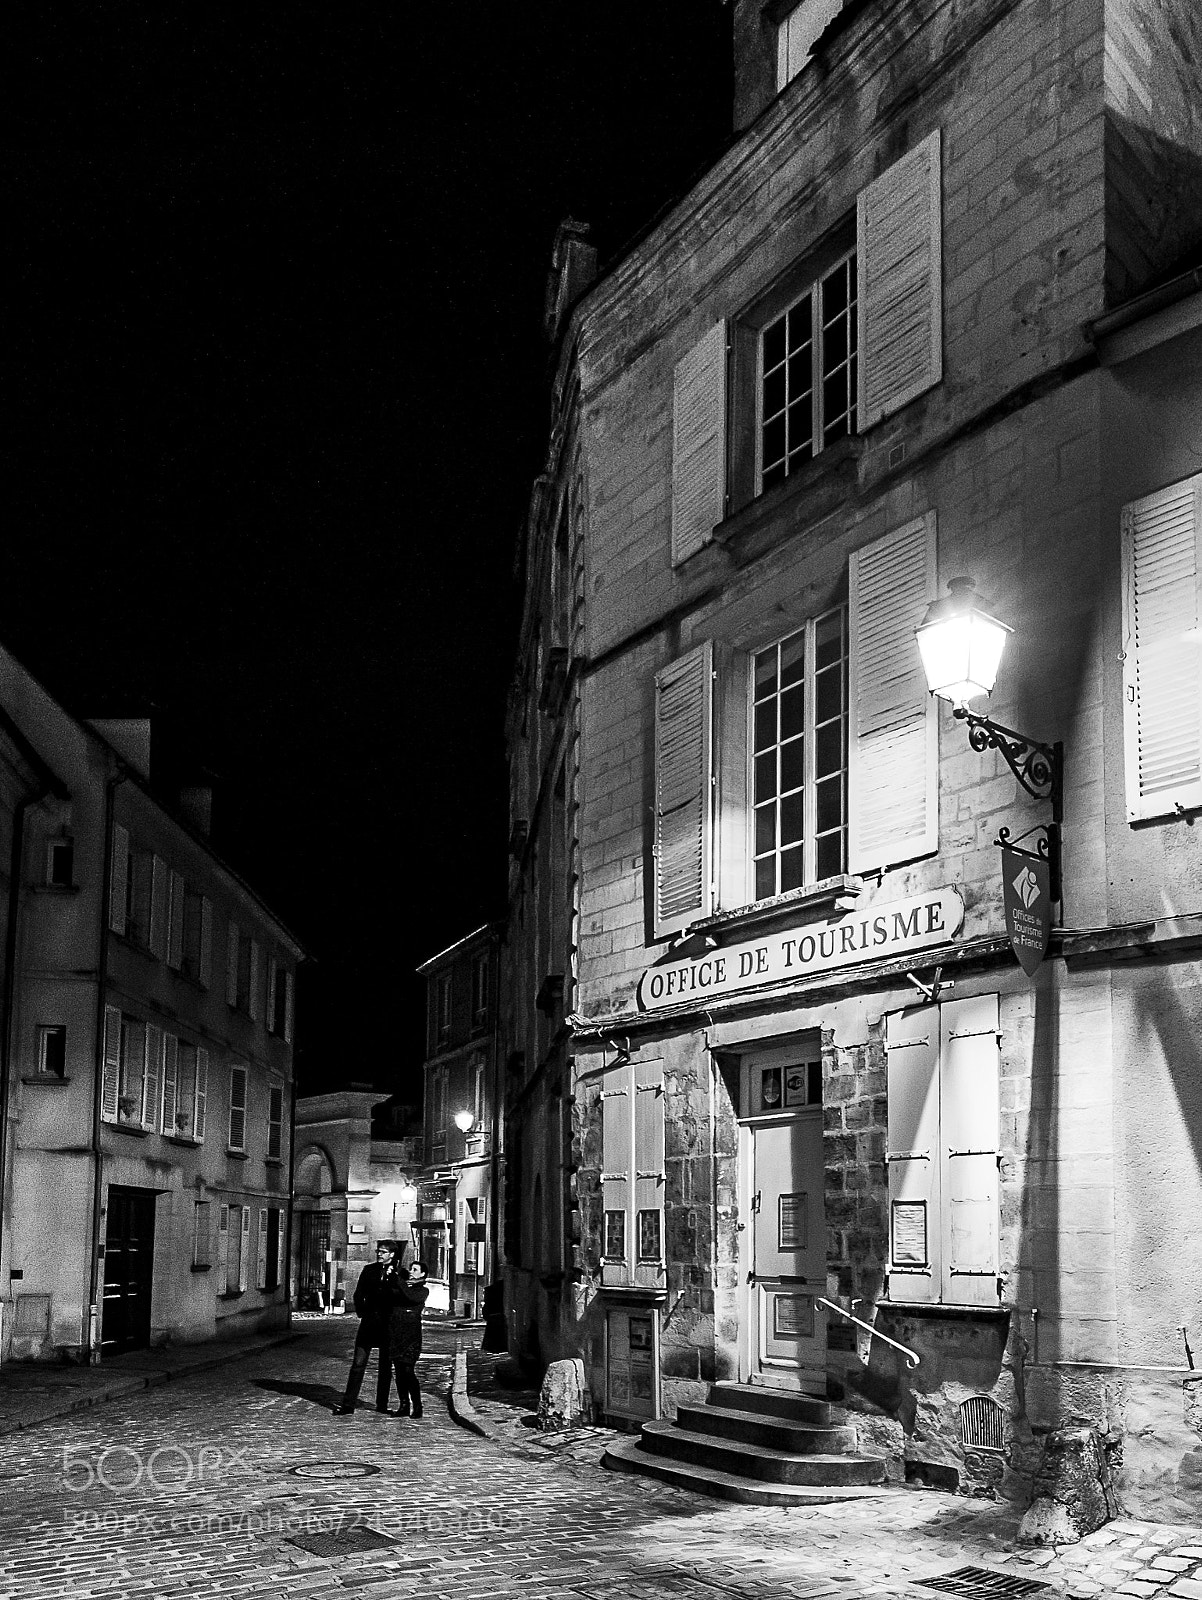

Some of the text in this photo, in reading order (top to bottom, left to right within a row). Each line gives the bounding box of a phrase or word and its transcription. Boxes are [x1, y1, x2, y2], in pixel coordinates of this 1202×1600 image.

[1012, 908, 1035, 924] Offices
[1013, 920, 1043, 938] Tourisme
[649, 900, 945, 999] OFFICE DE TOURISME
[1020, 934, 1043, 950] France
